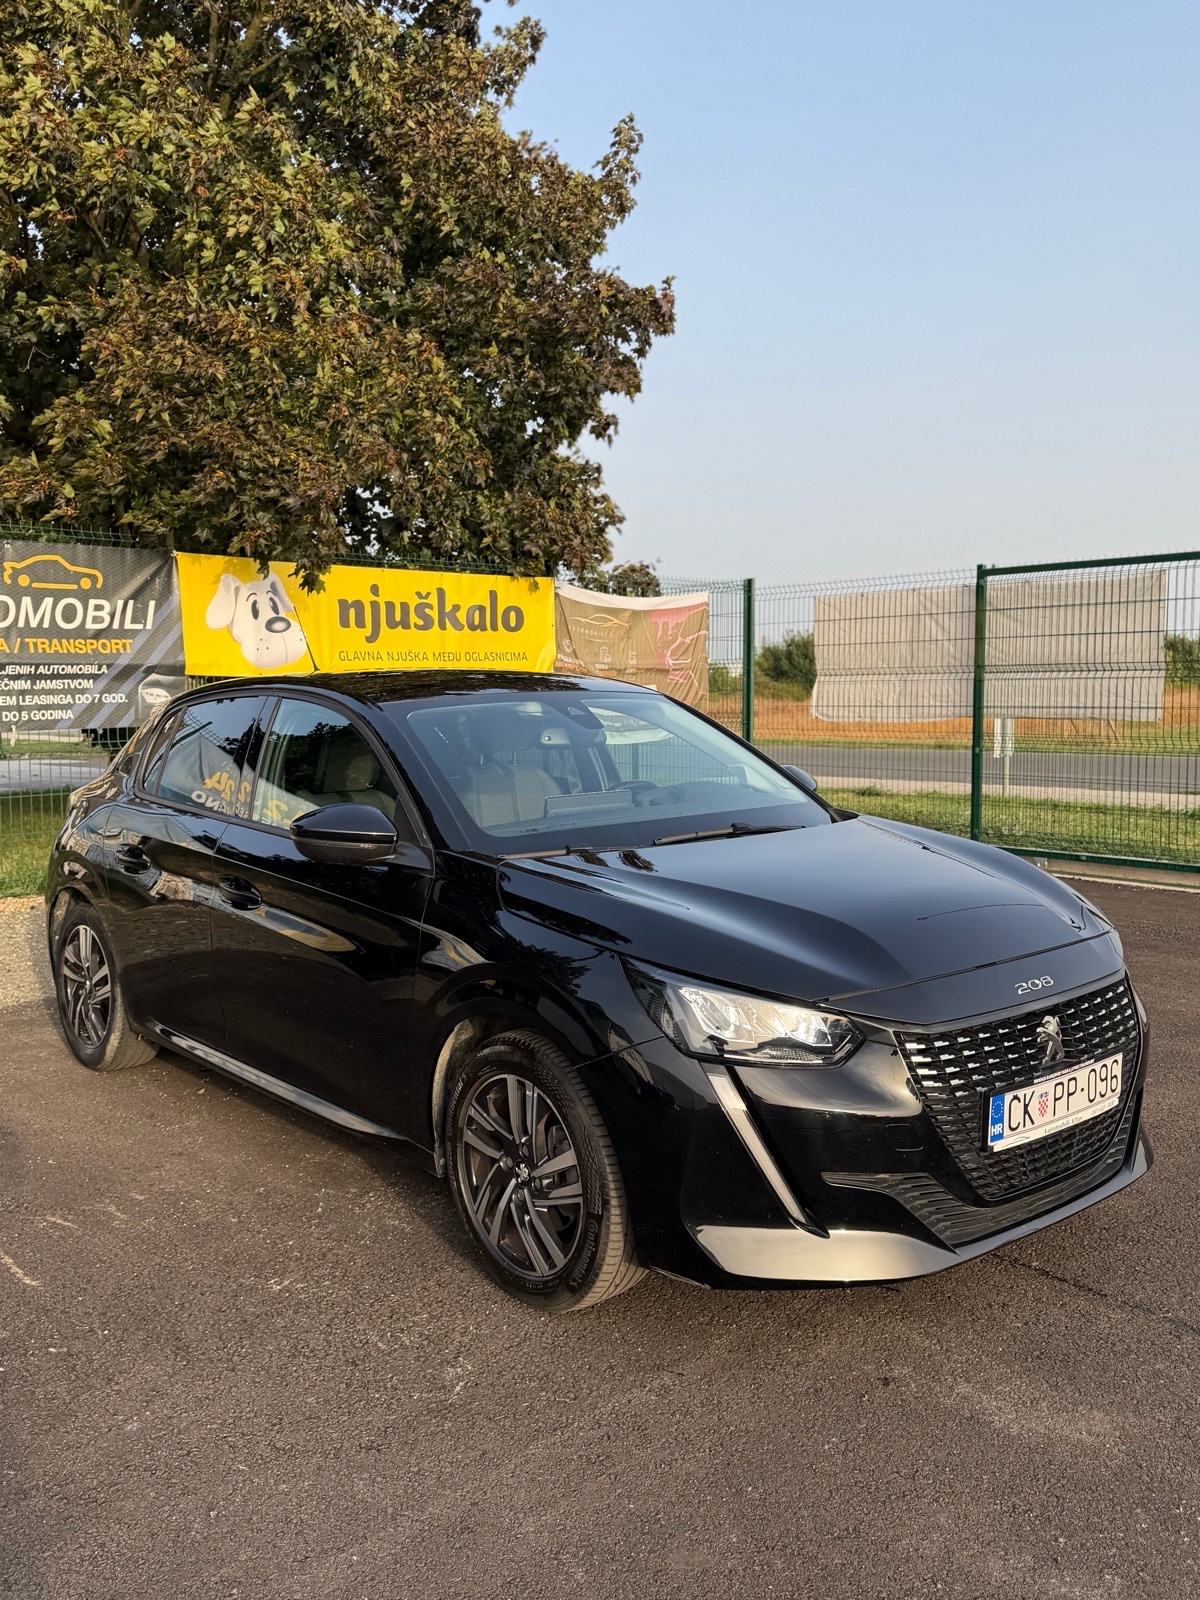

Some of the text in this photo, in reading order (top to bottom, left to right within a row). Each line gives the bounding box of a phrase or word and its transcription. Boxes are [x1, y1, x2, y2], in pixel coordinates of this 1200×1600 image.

[0, 594, 156, 630] OMOBILI
[337, 583, 525, 644] njuškalo
[25, 638, 133, 654] TRANSPORT
[338, 650, 384, 662] GLAVNA
[386, 649, 429, 662] NJUŠKA
[464, 651, 529, 662] OGLASNICIMA
[0, 664, 108, 675] JENIH AUTOMOBILA
[0, 678, 93, 690] ČNIM JAMSTVOM
[19, 694, 73, 706] LEASINGA
[75, 694, 91, 704] DO
[92, 694, 100, 704] 7
[102, 693, 128, 704] GOD.
[2, 709, 74, 721] DO 5 GODINA
[1014, 975, 1055, 995] 208
[1008, 1090, 1036, 1132] ČK
[991, 1123, 1003, 1137] HR
